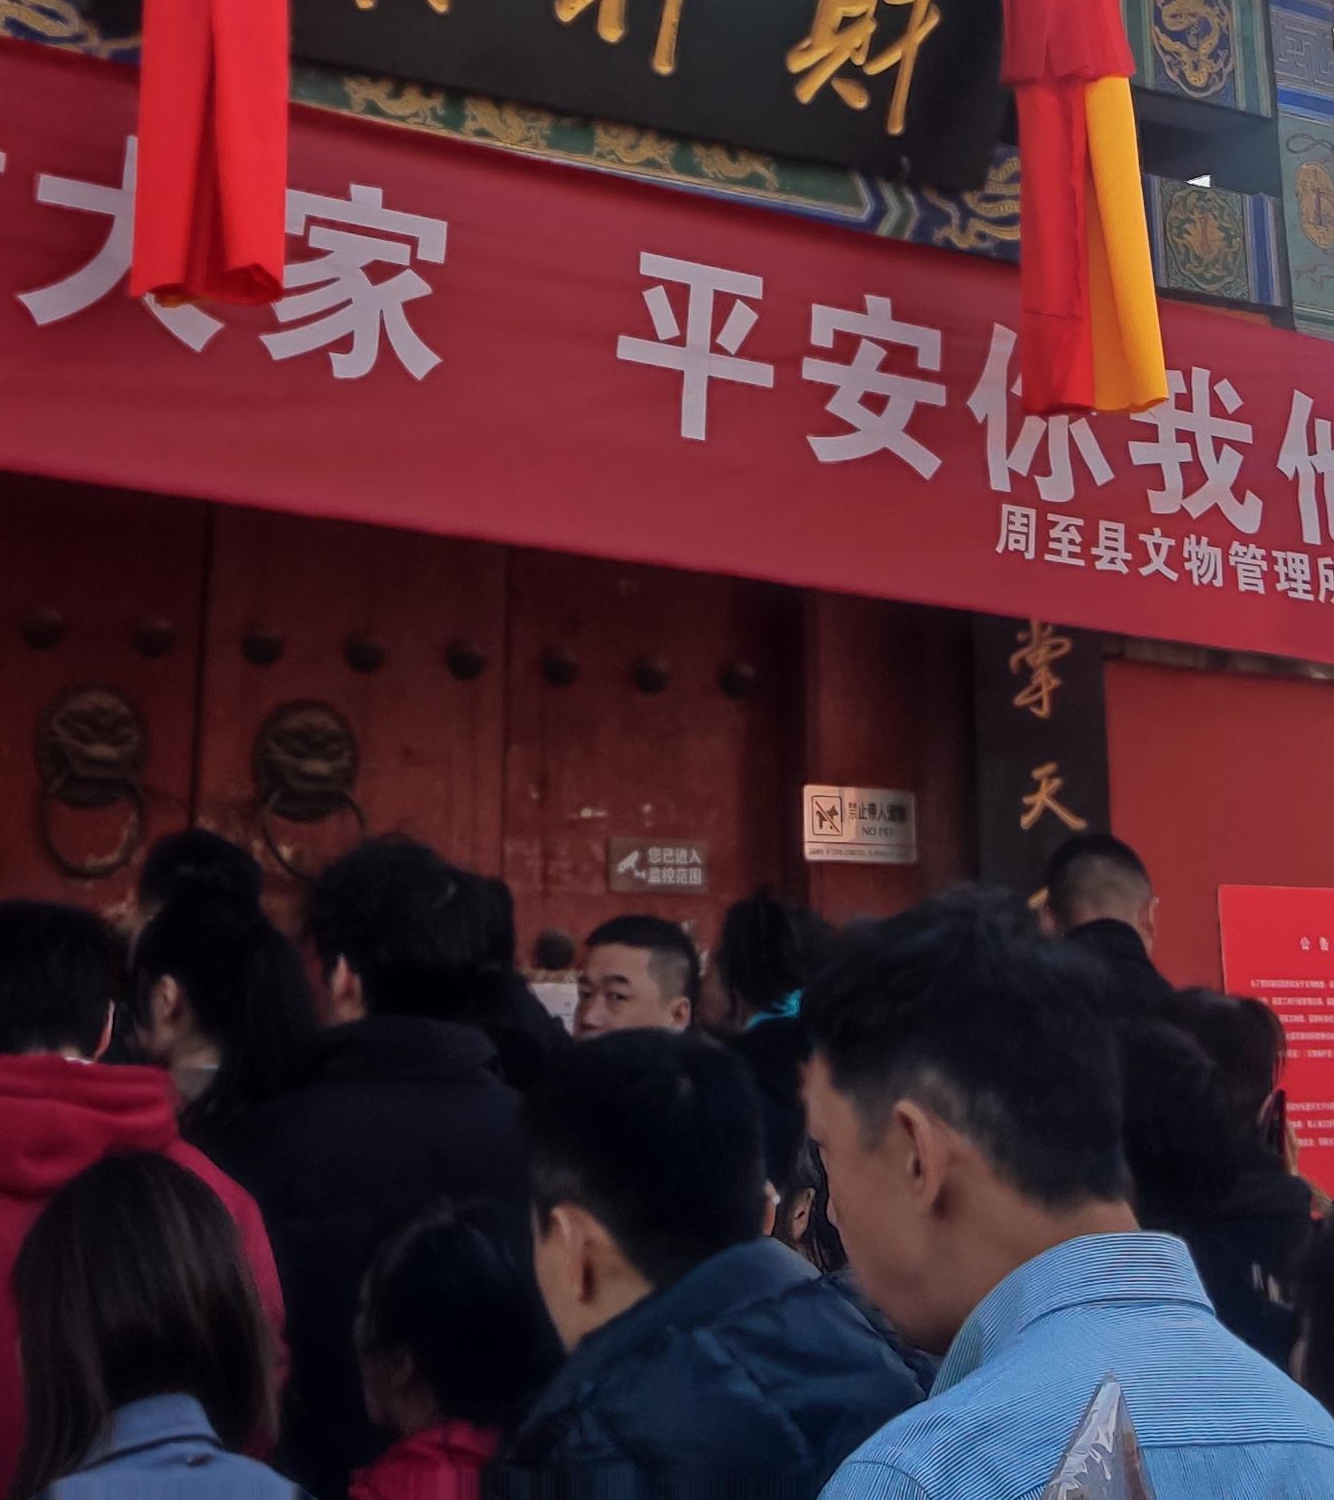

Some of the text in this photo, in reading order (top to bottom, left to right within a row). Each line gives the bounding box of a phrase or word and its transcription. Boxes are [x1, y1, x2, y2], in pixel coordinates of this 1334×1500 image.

[649, 847, 701, 864] 您已进入
[649, 867, 702, 884] 监控范围
